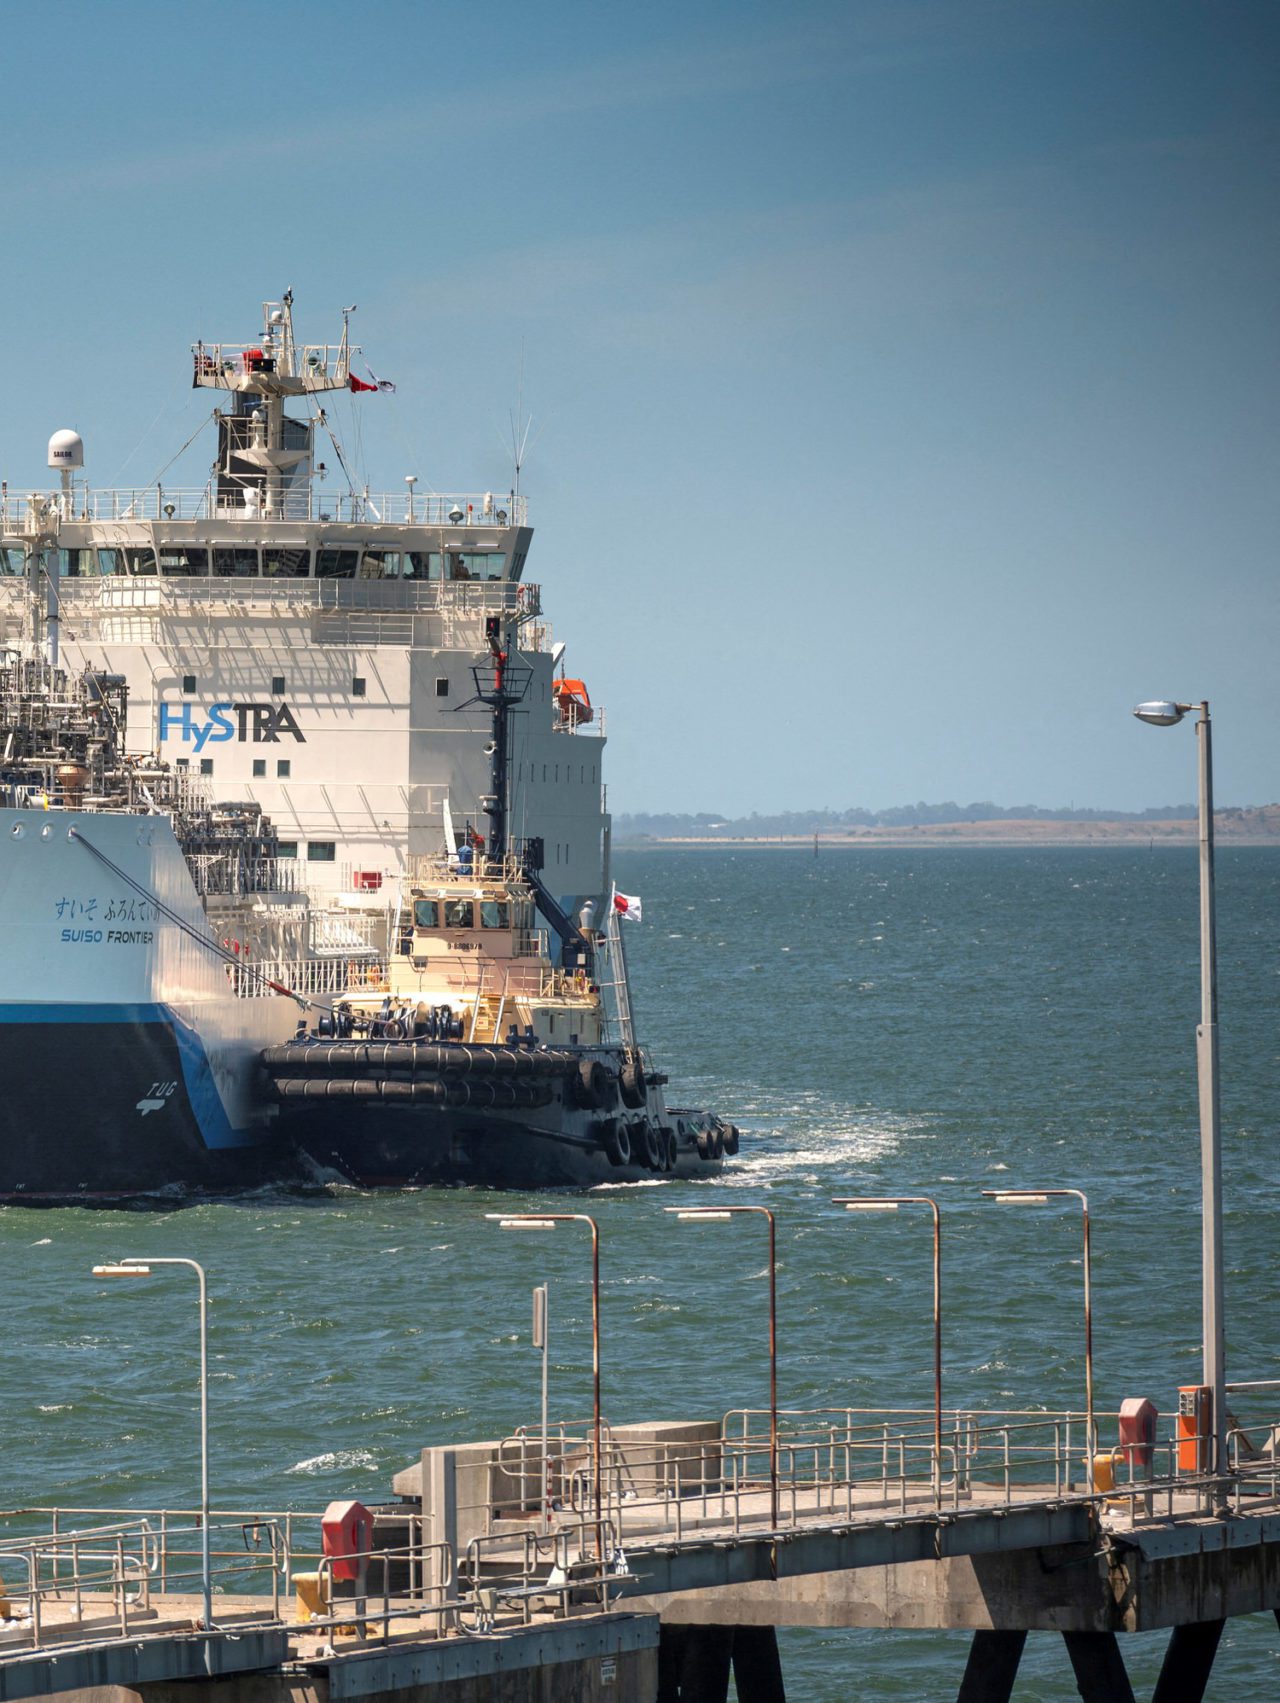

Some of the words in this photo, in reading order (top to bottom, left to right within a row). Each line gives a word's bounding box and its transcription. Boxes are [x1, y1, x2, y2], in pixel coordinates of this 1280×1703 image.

[160, 702, 307, 753] HySTRA
[56, 897, 98, 921] すいそ
[61, 929, 103, 943] SUISO
[107, 930, 154, 944] FRONTIER
[146, 1081, 178, 1097] TUG
